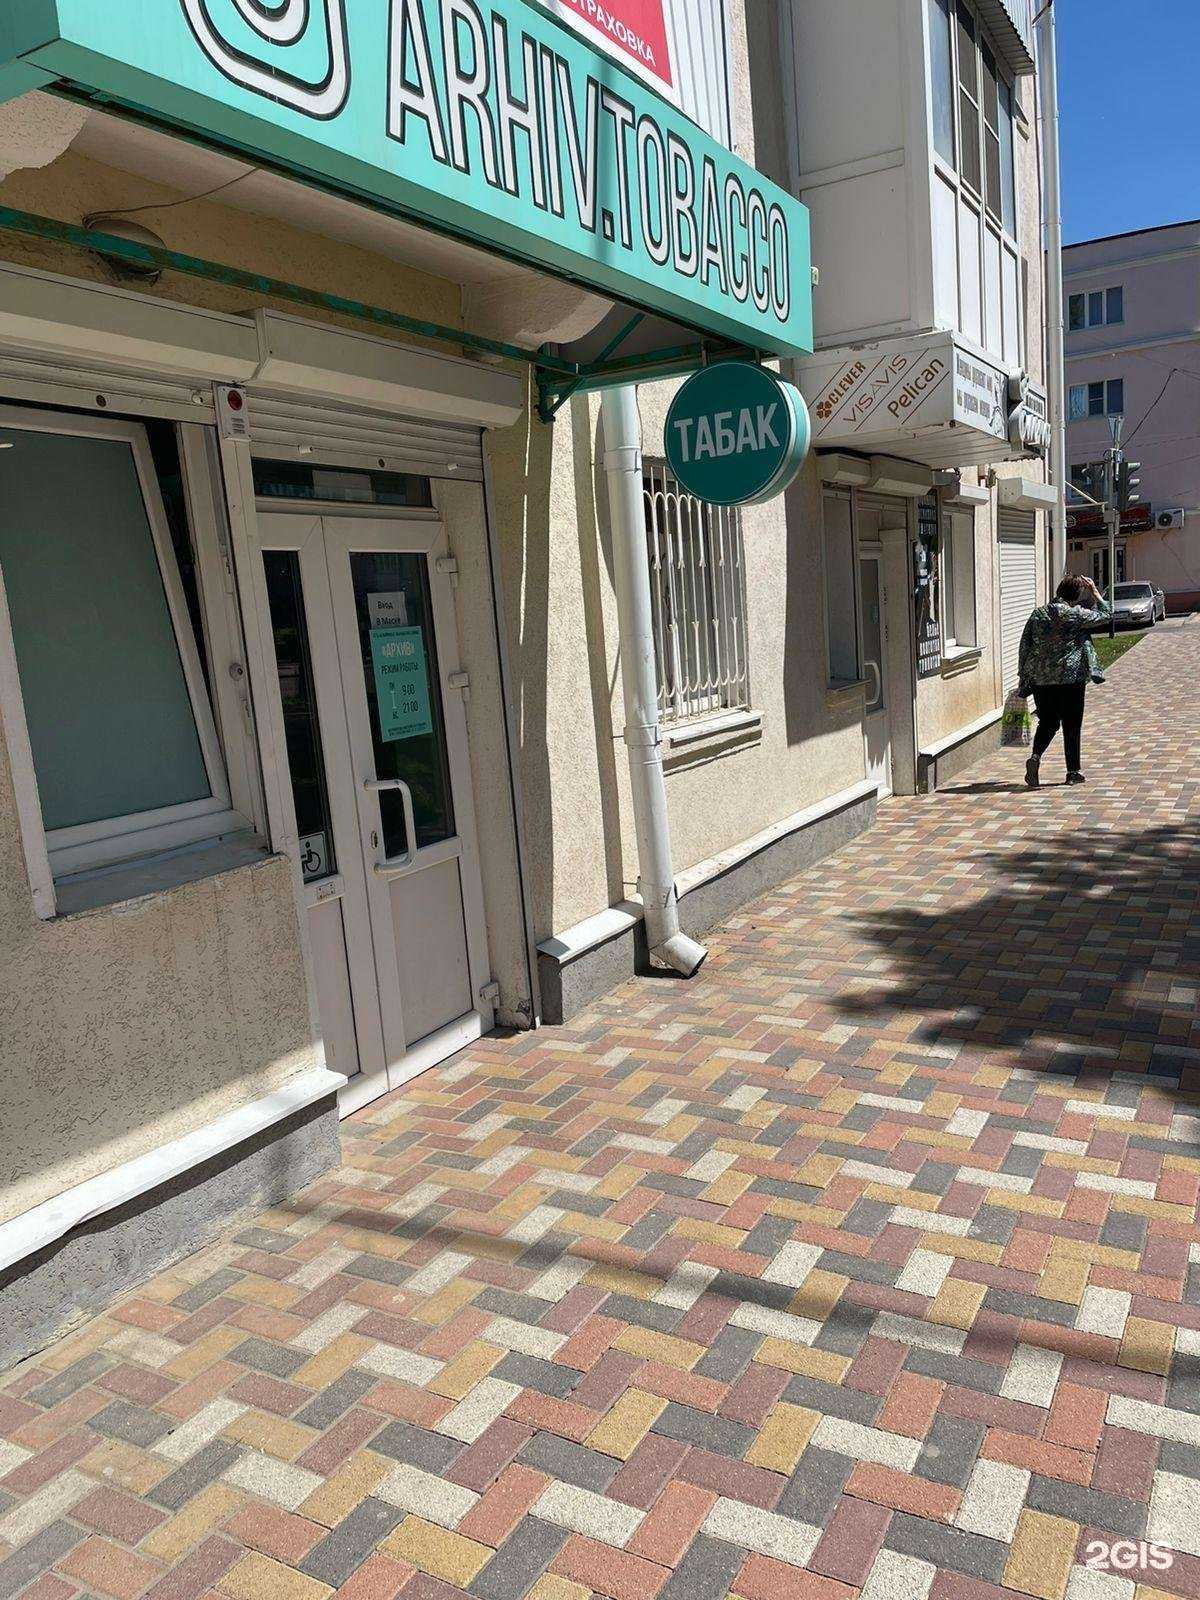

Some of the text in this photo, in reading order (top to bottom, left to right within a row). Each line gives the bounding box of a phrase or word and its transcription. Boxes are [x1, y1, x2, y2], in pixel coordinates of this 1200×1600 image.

[571, 0, 657, 67] ТРАХОВКА
[385, 0, 791, 324] ARHIV.TOBACCO
[828, 361, 866, 404] CLEVER
[887, 358, 944, 418] Pelican
[673, 402, 781, 463] ТАБАК
